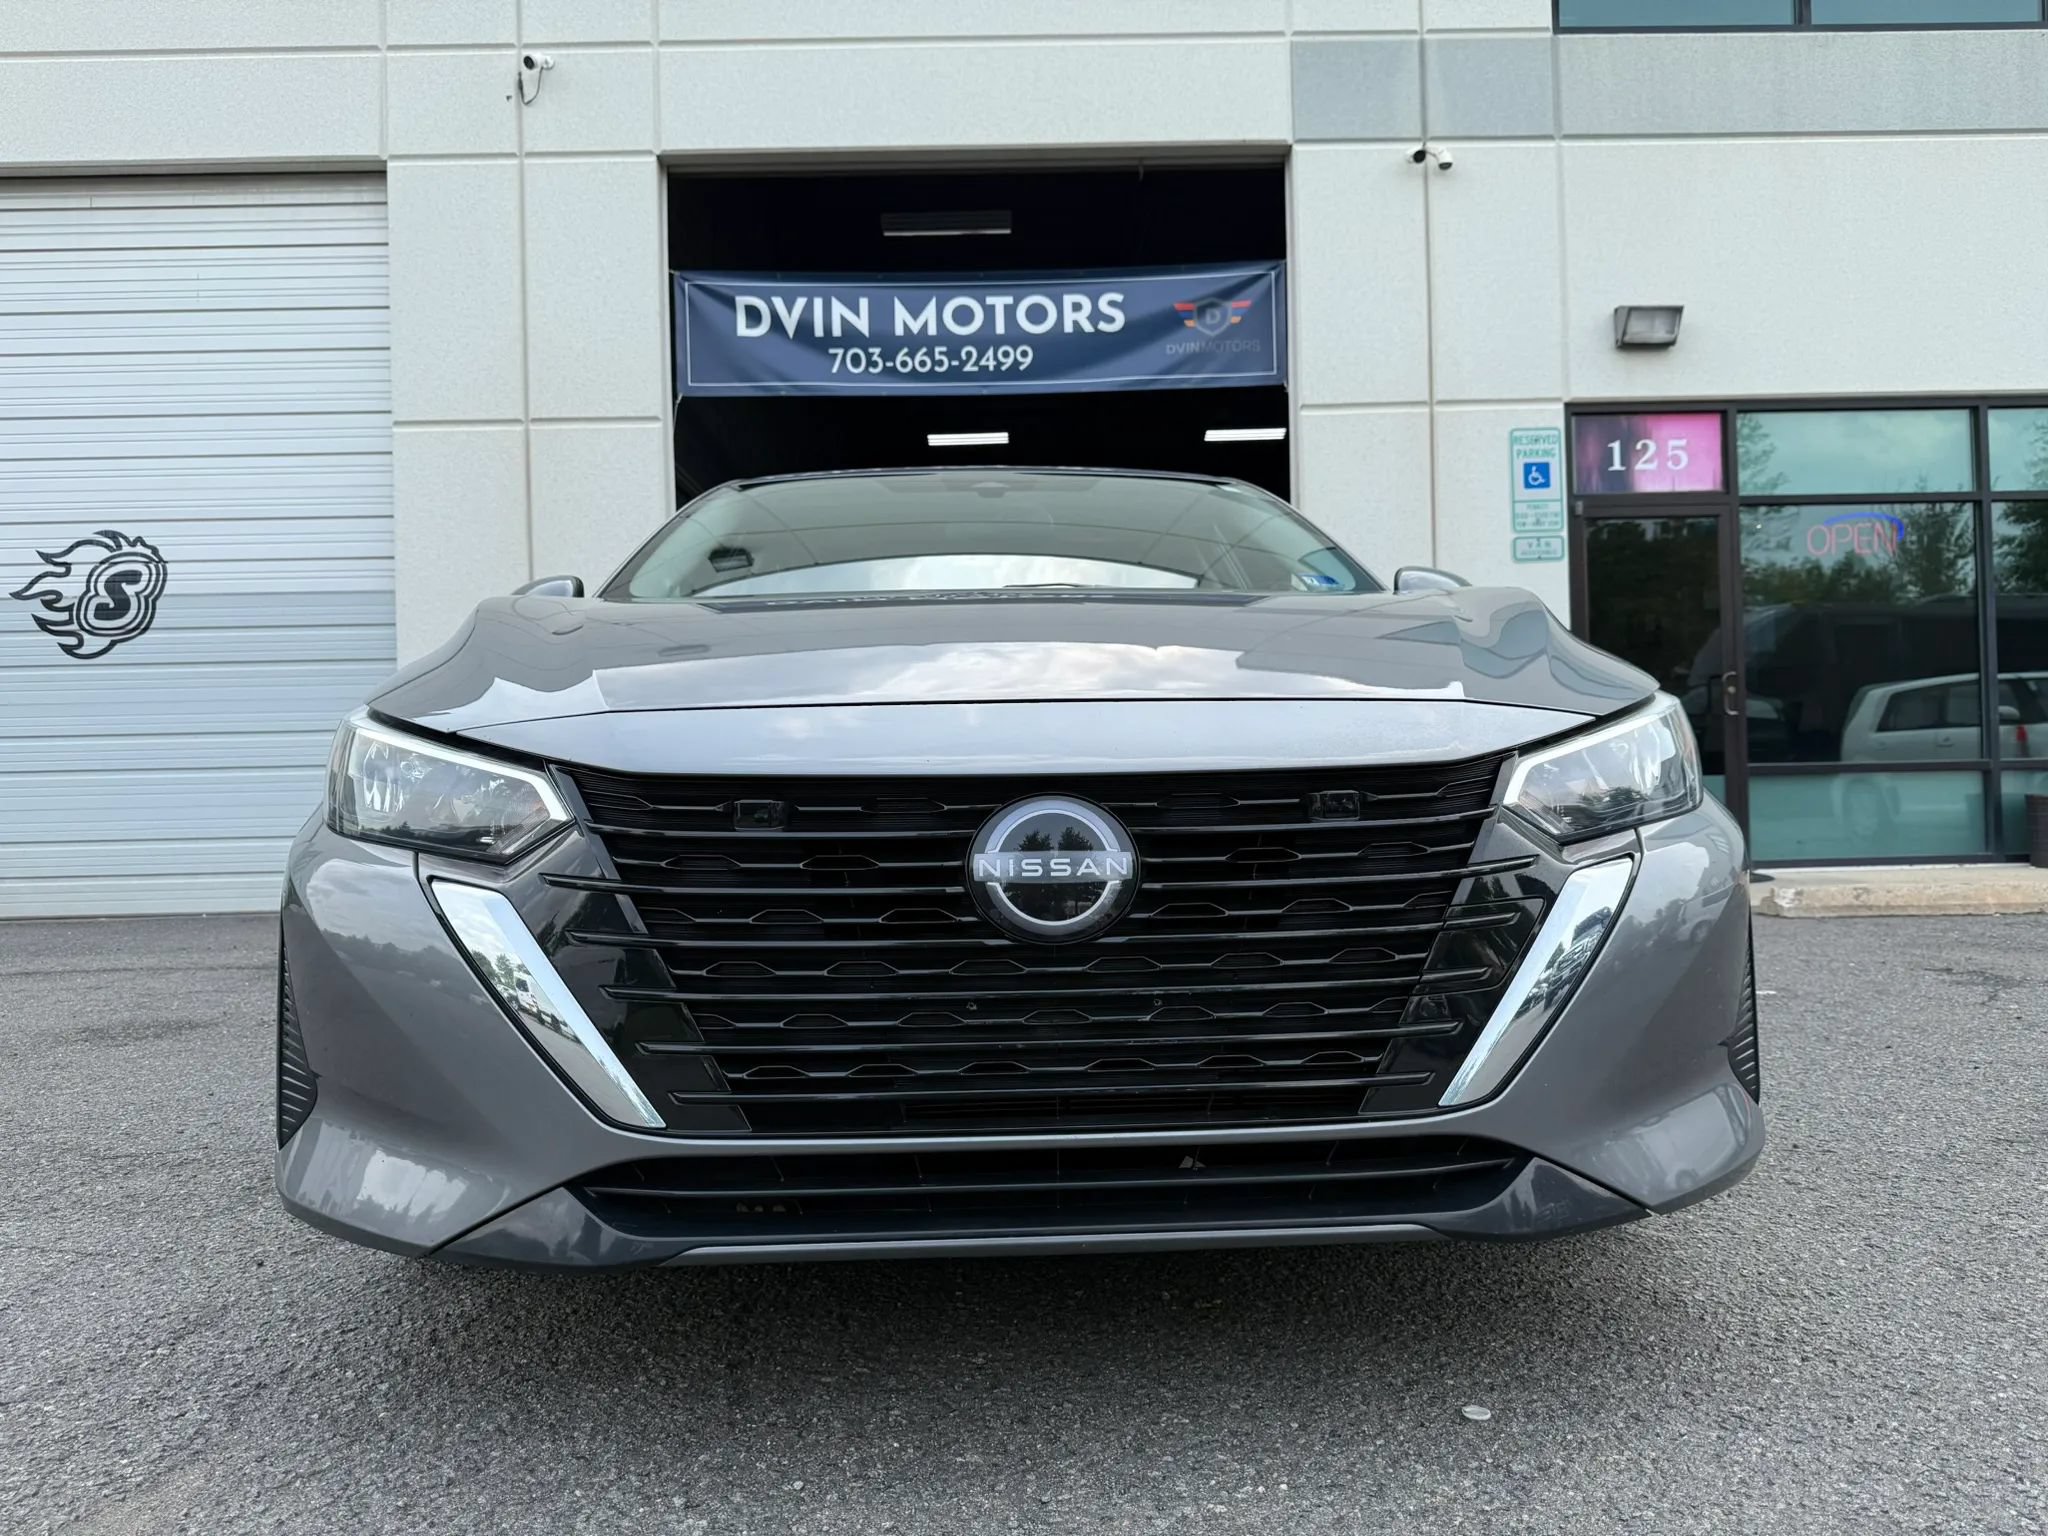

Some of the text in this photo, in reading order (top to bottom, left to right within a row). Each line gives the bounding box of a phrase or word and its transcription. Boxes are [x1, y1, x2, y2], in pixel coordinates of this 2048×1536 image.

[734, 292, 1126, 338] DVIN MOTORS
[828, 345, 1034, 374] 703-665-2499
[1512, 434, 1558, 445] RESERVED
[1516, 448, 1556, 459] PARKING
[1607, 438, 1689, 471] 125
[1807, 521, 1898, 557] OPEN
[978, 856, 1128, 877] NISSAN
